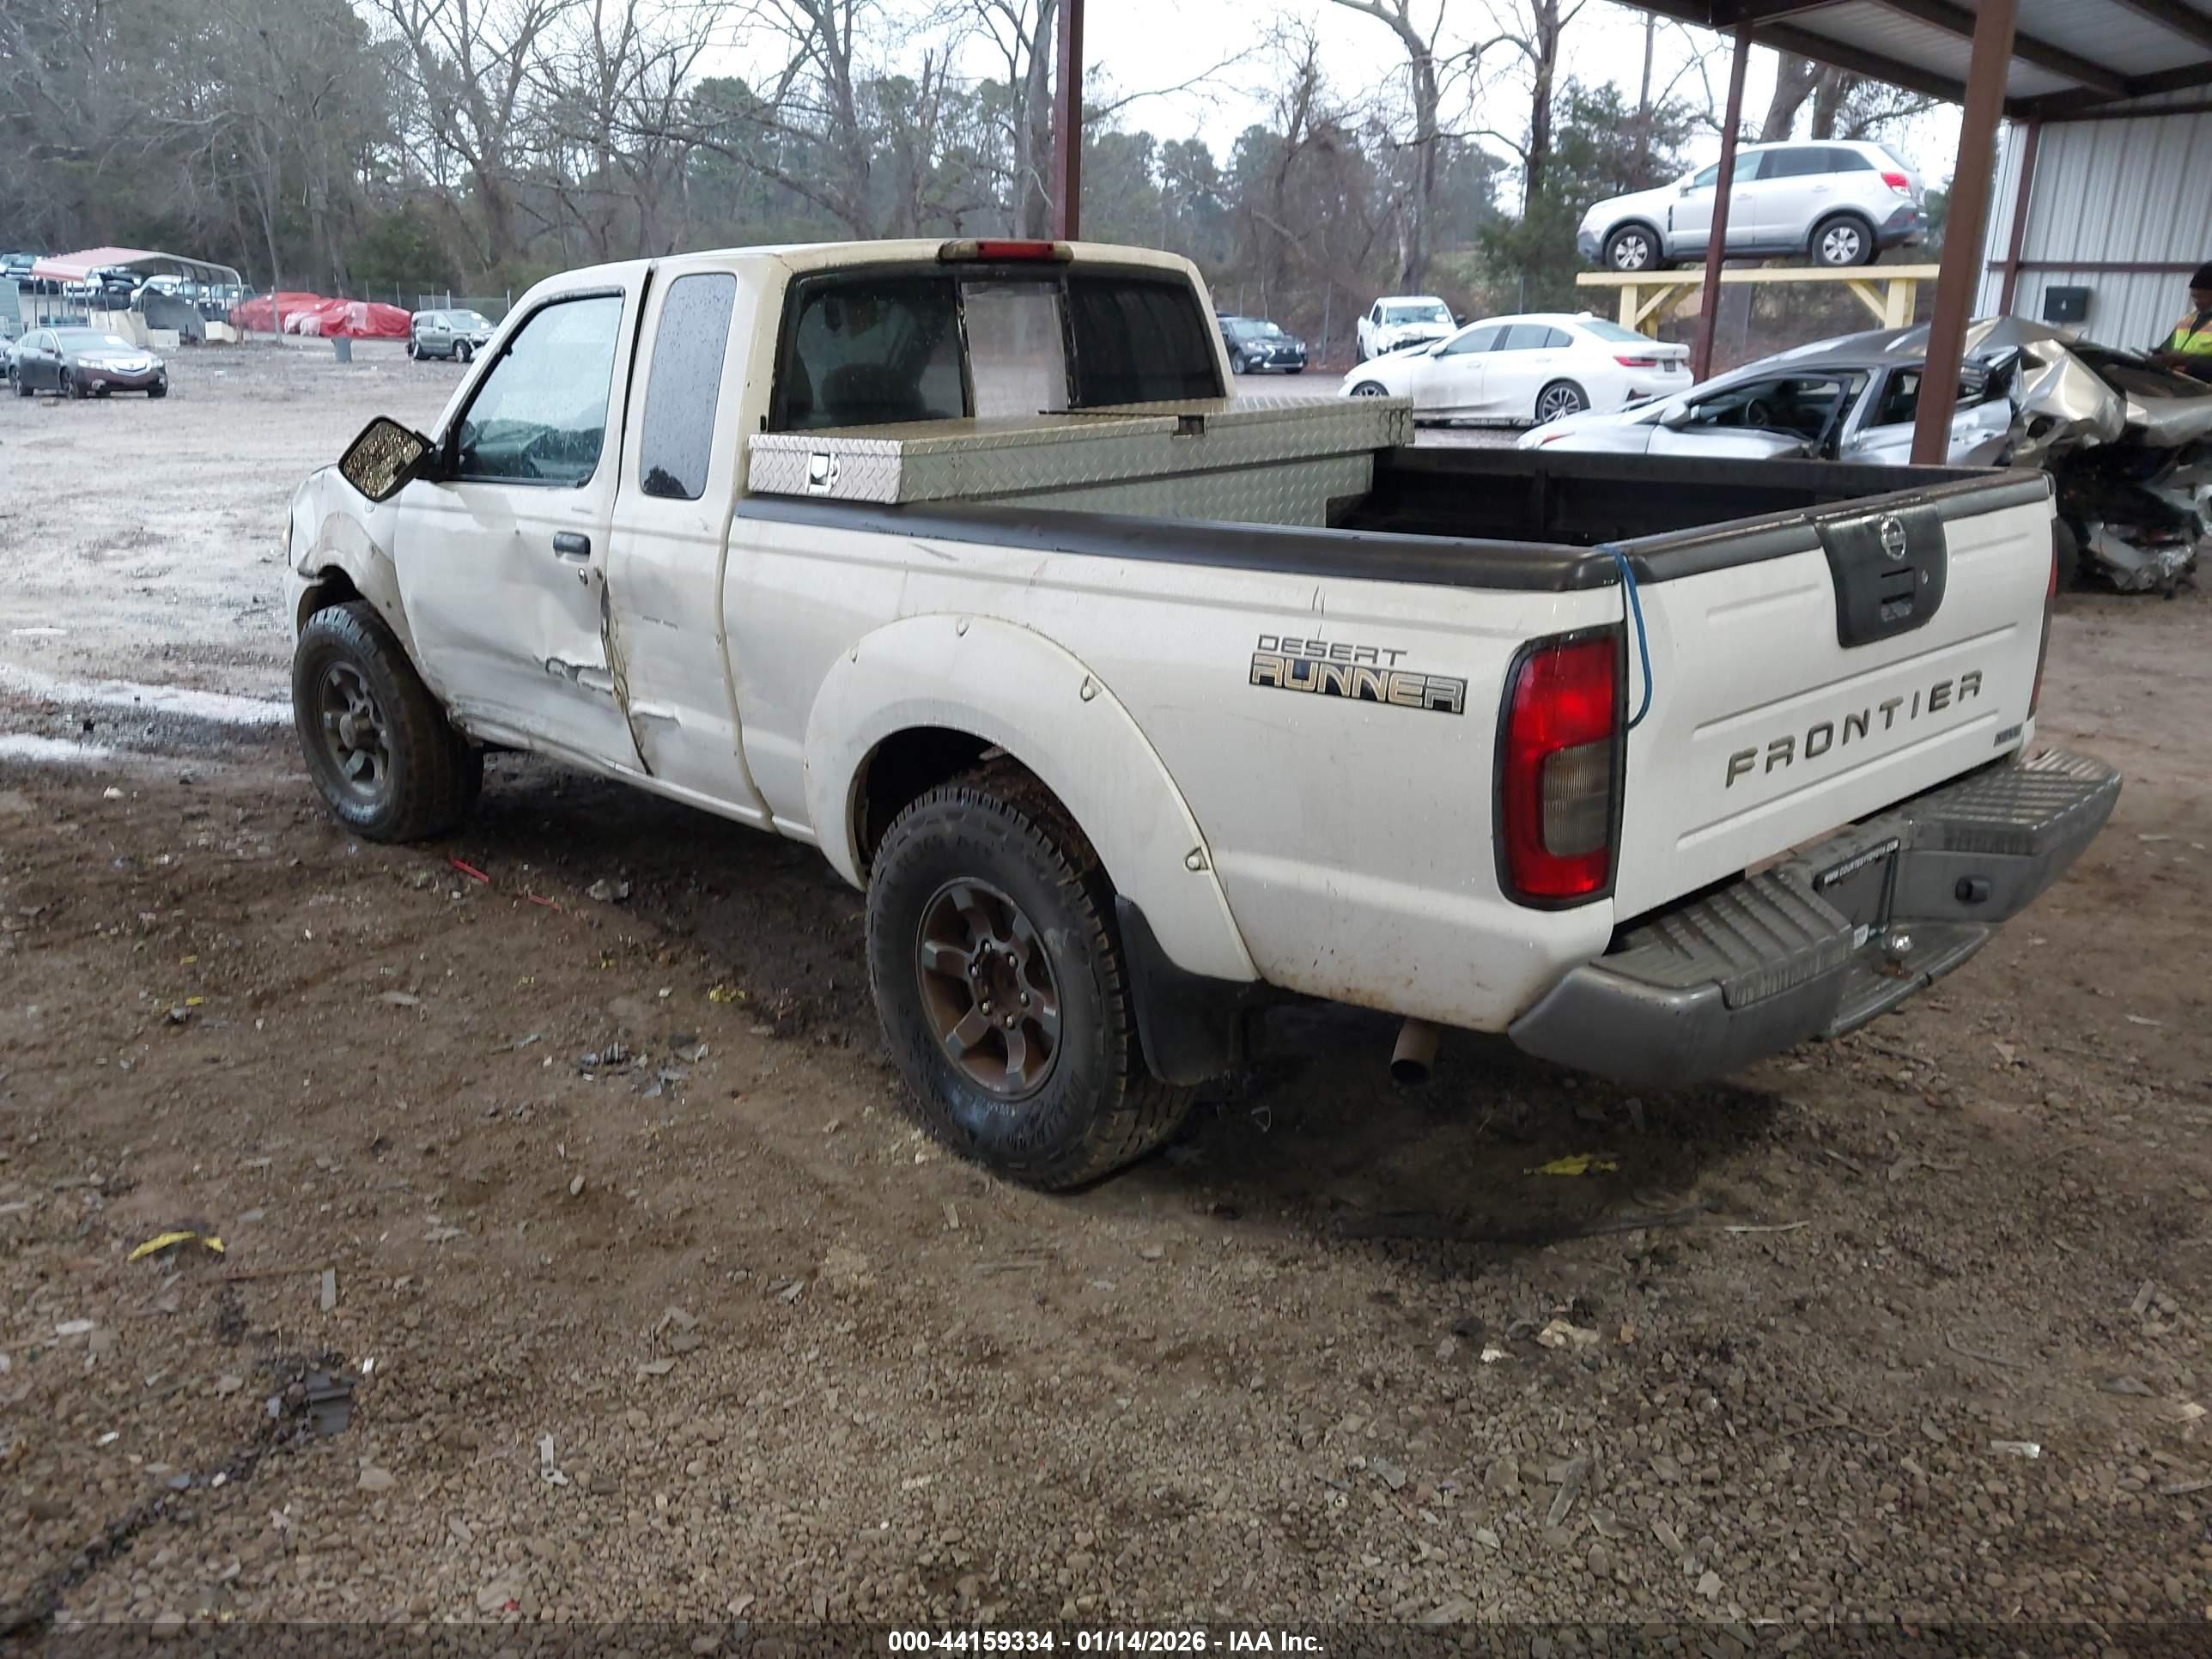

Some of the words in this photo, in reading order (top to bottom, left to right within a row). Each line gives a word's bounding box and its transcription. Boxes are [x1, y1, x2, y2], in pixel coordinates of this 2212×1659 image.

[1257, 634, 1408, 666] DESERT
[1250, 653, 1467, 714] RUNNER
[1725, 669, 1983, 788] FRONTIER
